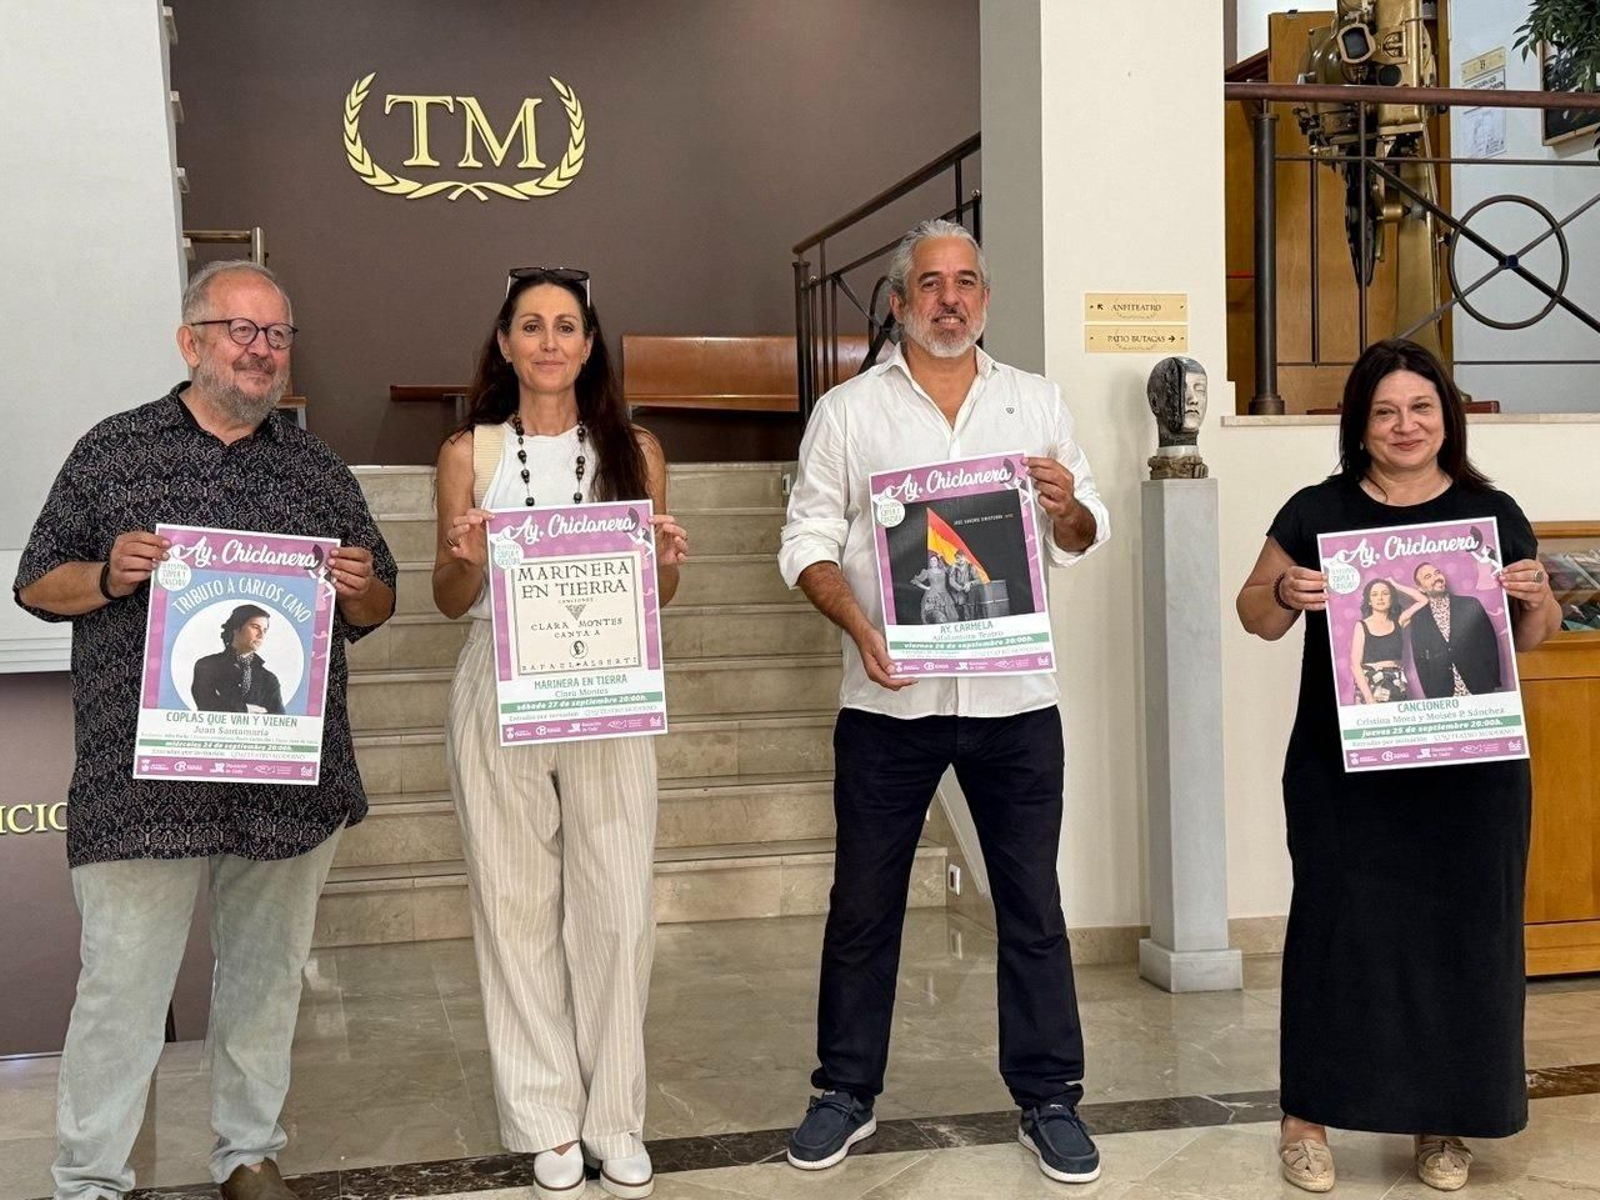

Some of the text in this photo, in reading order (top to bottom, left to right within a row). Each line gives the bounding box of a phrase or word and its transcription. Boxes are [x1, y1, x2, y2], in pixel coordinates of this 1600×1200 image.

[385, 94, 546, 169] TM
[1111, 304, 1161, 312] ANFITEATRO
[1107, 335, 1166, 343] PATIO BUTACAS
[926, 466, 1012, 493] Chiclanera
[548, 514, 636, 538] Chiclanera
[221, 539, 319, 567] Chiclanera
[1384, 534, 1480, 561] Chiclanera
[517, 561, 630, 582] MARINERA
[522, 579, 628, 600] EN TIERRA
[171, 577, 312, 624] TRIBUTO A CARLOS CANO
[530, 617, 623, 631] CLARA MONTES
[954, 620, 994, 633] CARMELA
[554, 630, 590, 639] CANTA
[957, 639, 1003, 650] septiembre
[534, 673, 628, 690] MARINERA EN TIERRA
[554, 688, 609, 698] Clara Montes
[560, 699, 570, 707] de
[571, 695, 617, 708] septiembre
[1398, 699, 1460, 713] CANCIONERO
[166, 712, 298, 727] COPLAS QUE VAN Y VIENEN
[1356, 717, 1391, 726] Cristina
[1426, 711, 1457, 720] Moisés
[1467, 707, 1505, 717] Sánchez
[193, 726, 270, 736] Juan Santamaría
[1361, 729, 1391, 739] jueves
[1418, 722, 1469, 734] septiembre
[224, 742, 267, 751] septiembre
